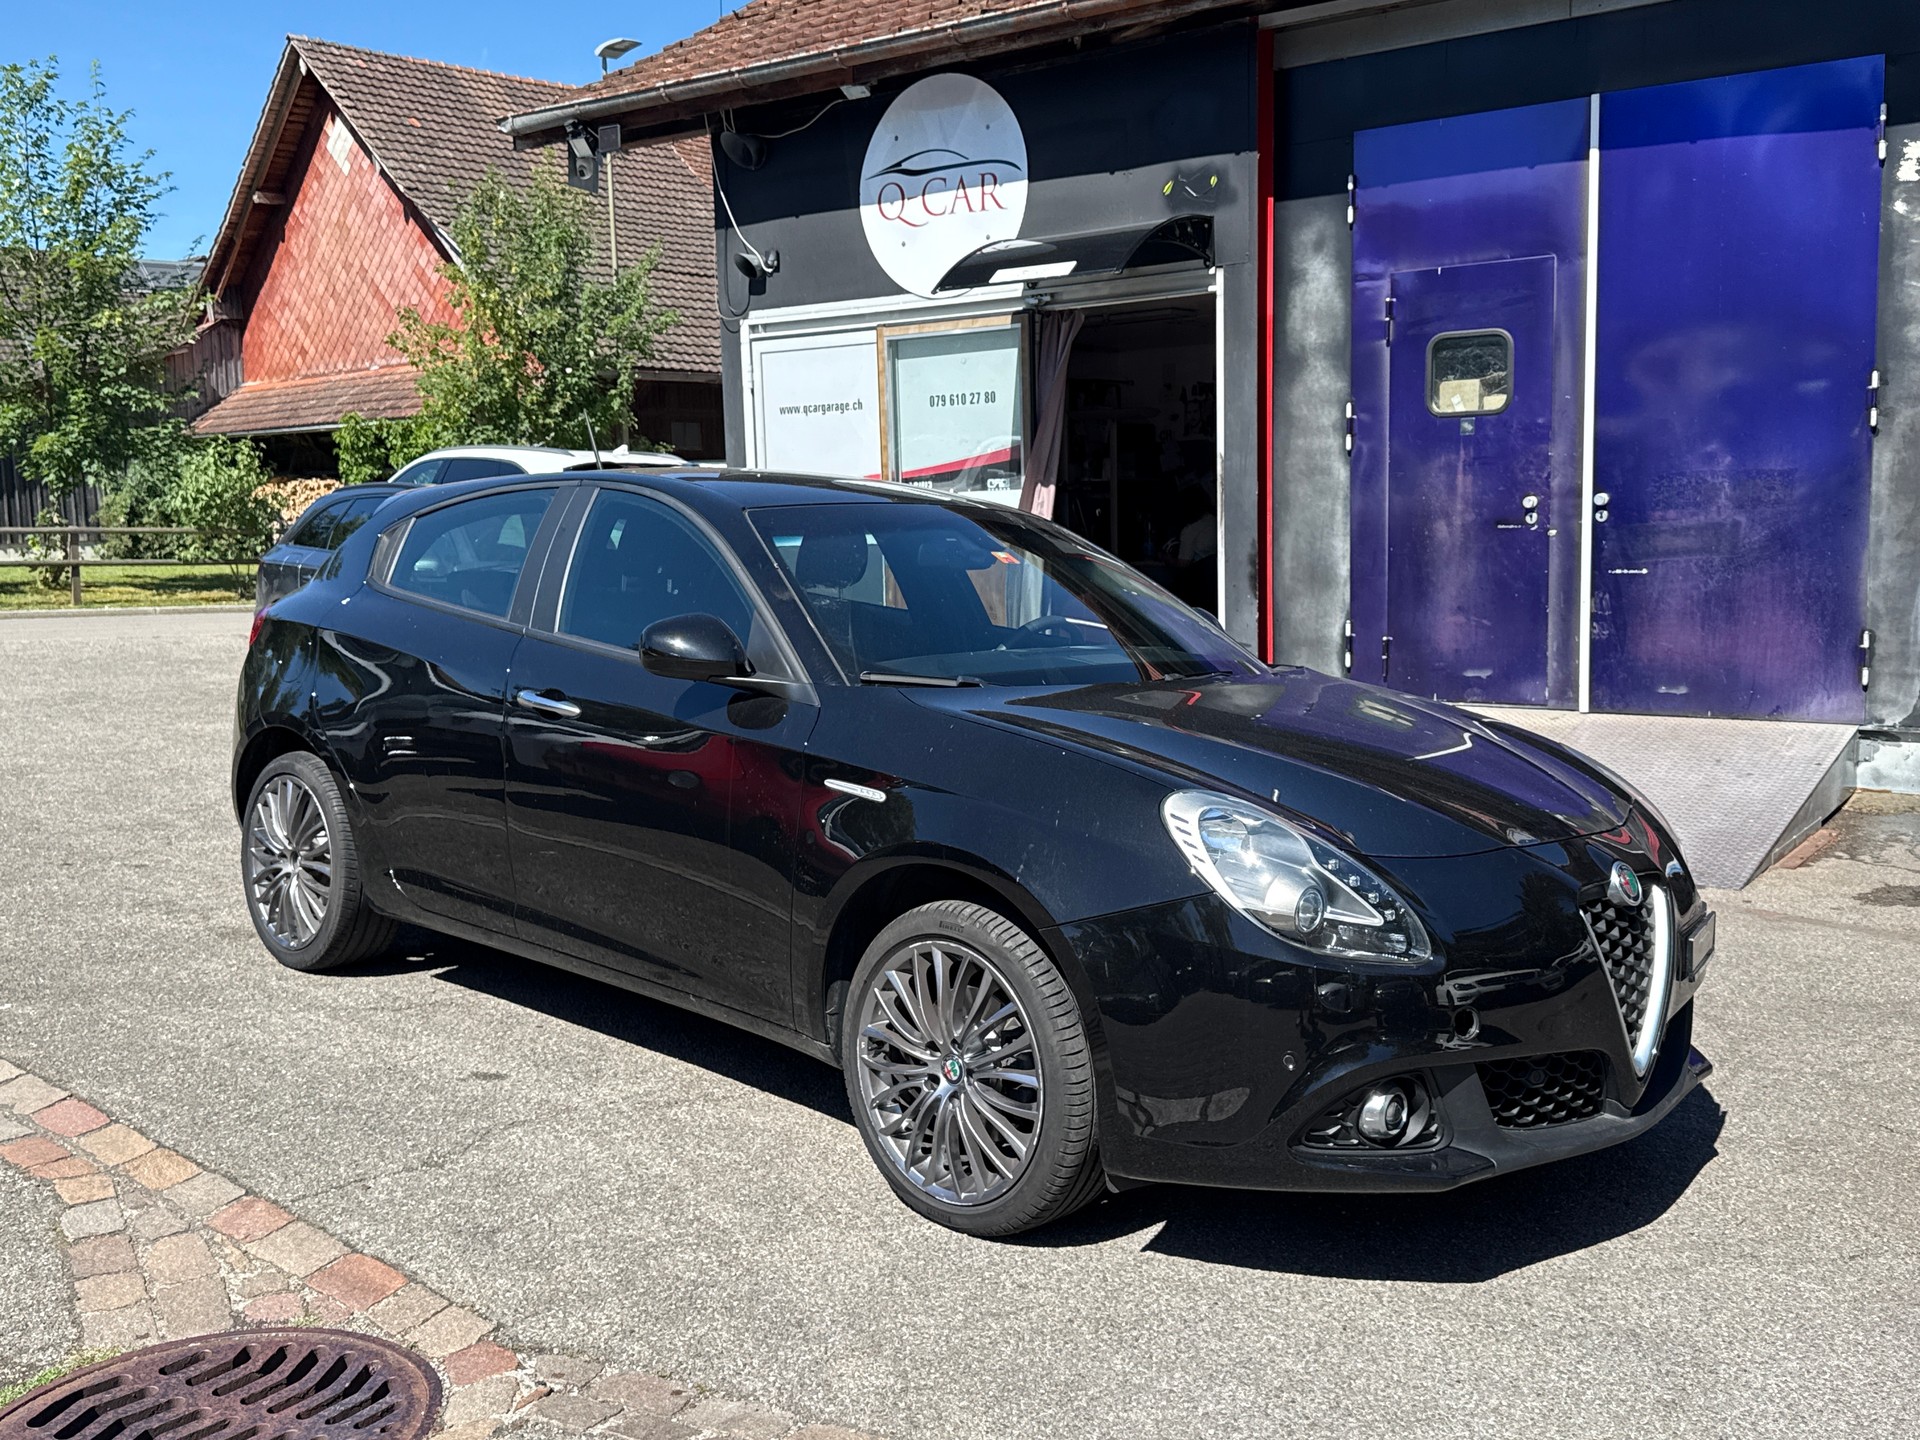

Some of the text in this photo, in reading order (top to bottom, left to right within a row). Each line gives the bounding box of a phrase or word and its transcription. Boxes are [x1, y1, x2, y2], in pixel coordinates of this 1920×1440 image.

[779, 398, 863, 416] www.qcargarage.ch
[929, 390, 996, 408] 079 610 27 80
